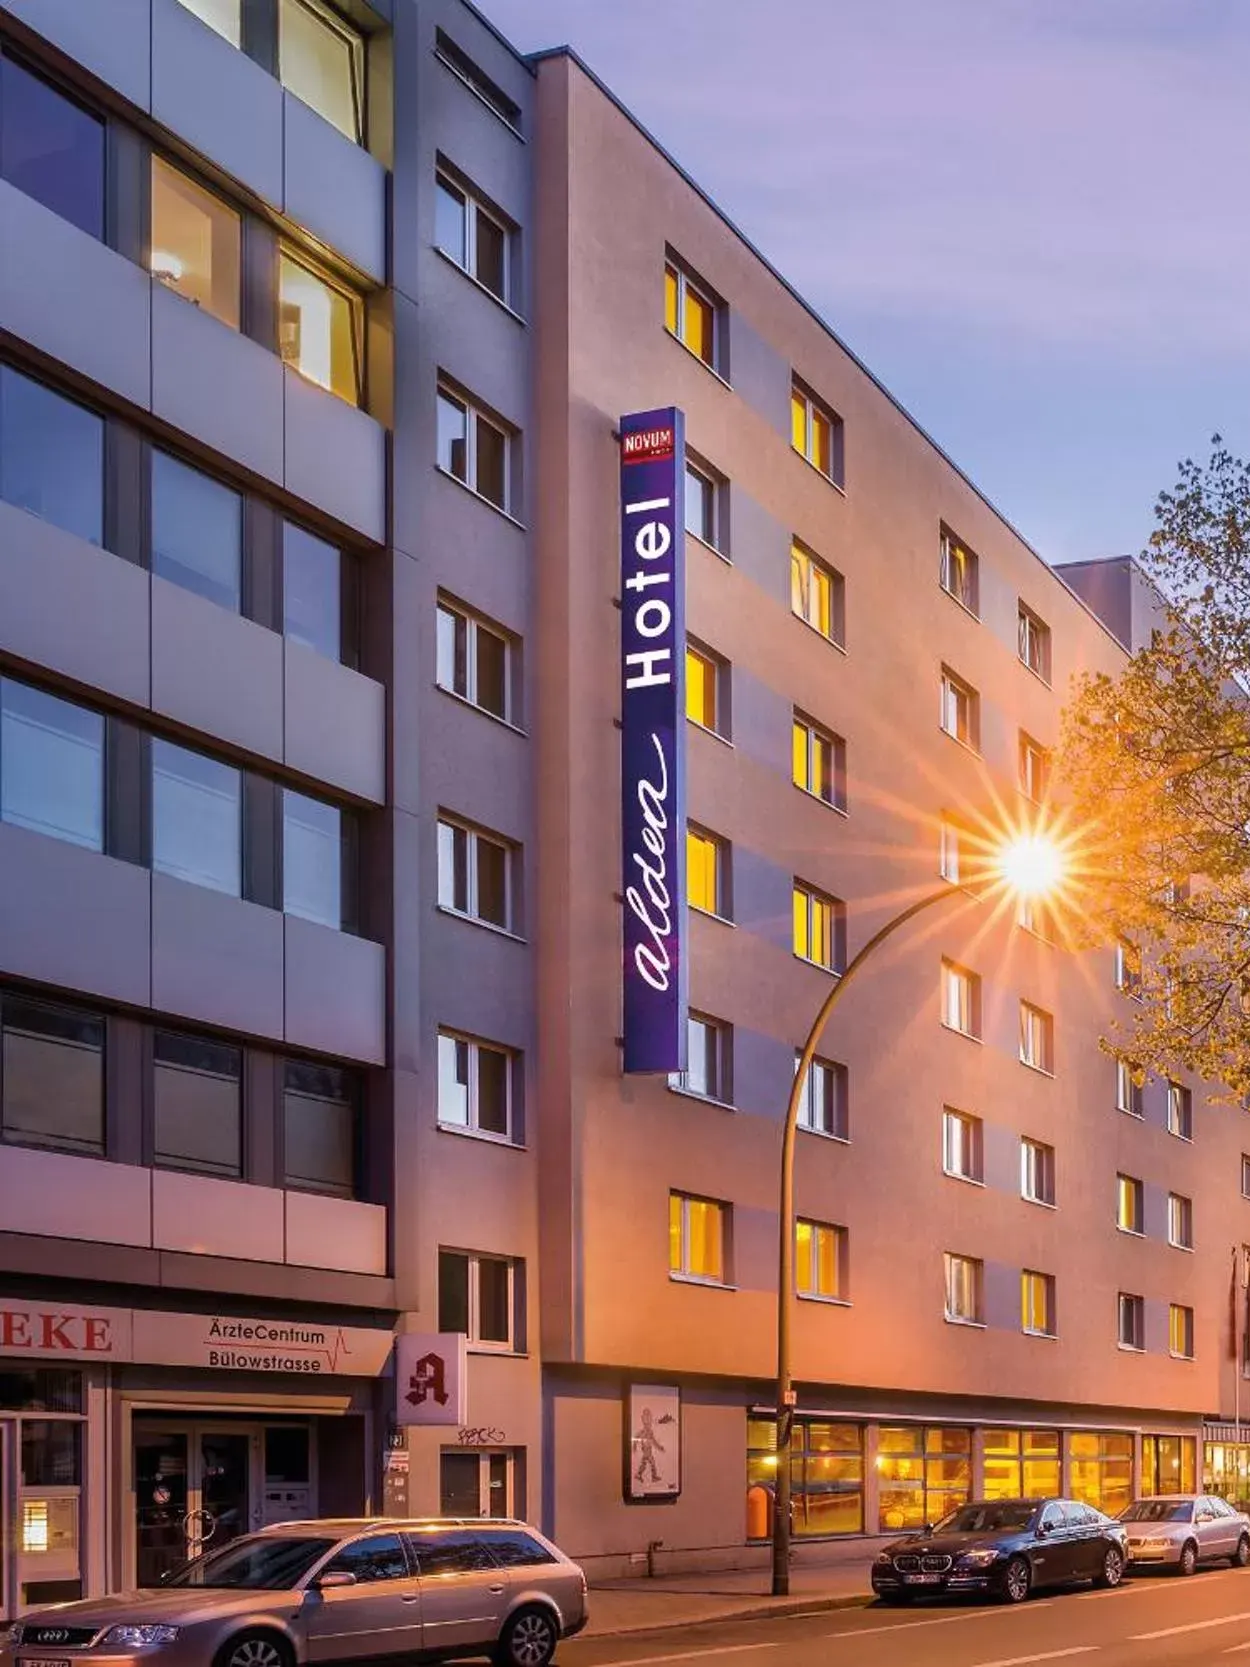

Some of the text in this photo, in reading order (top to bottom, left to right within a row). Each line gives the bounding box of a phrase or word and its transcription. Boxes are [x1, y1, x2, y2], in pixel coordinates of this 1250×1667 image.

[625, 430, 671, 453] NOVUM
[626, 497, 671, 689] Hotel
[626, 733, 671, 991] aldea
[0, 1311, 112, 1352] EKE
[209, 1318, 325, 1344] ÄrzteCentrum
[209, 1351, 321, 1371] Bülowstrasse
